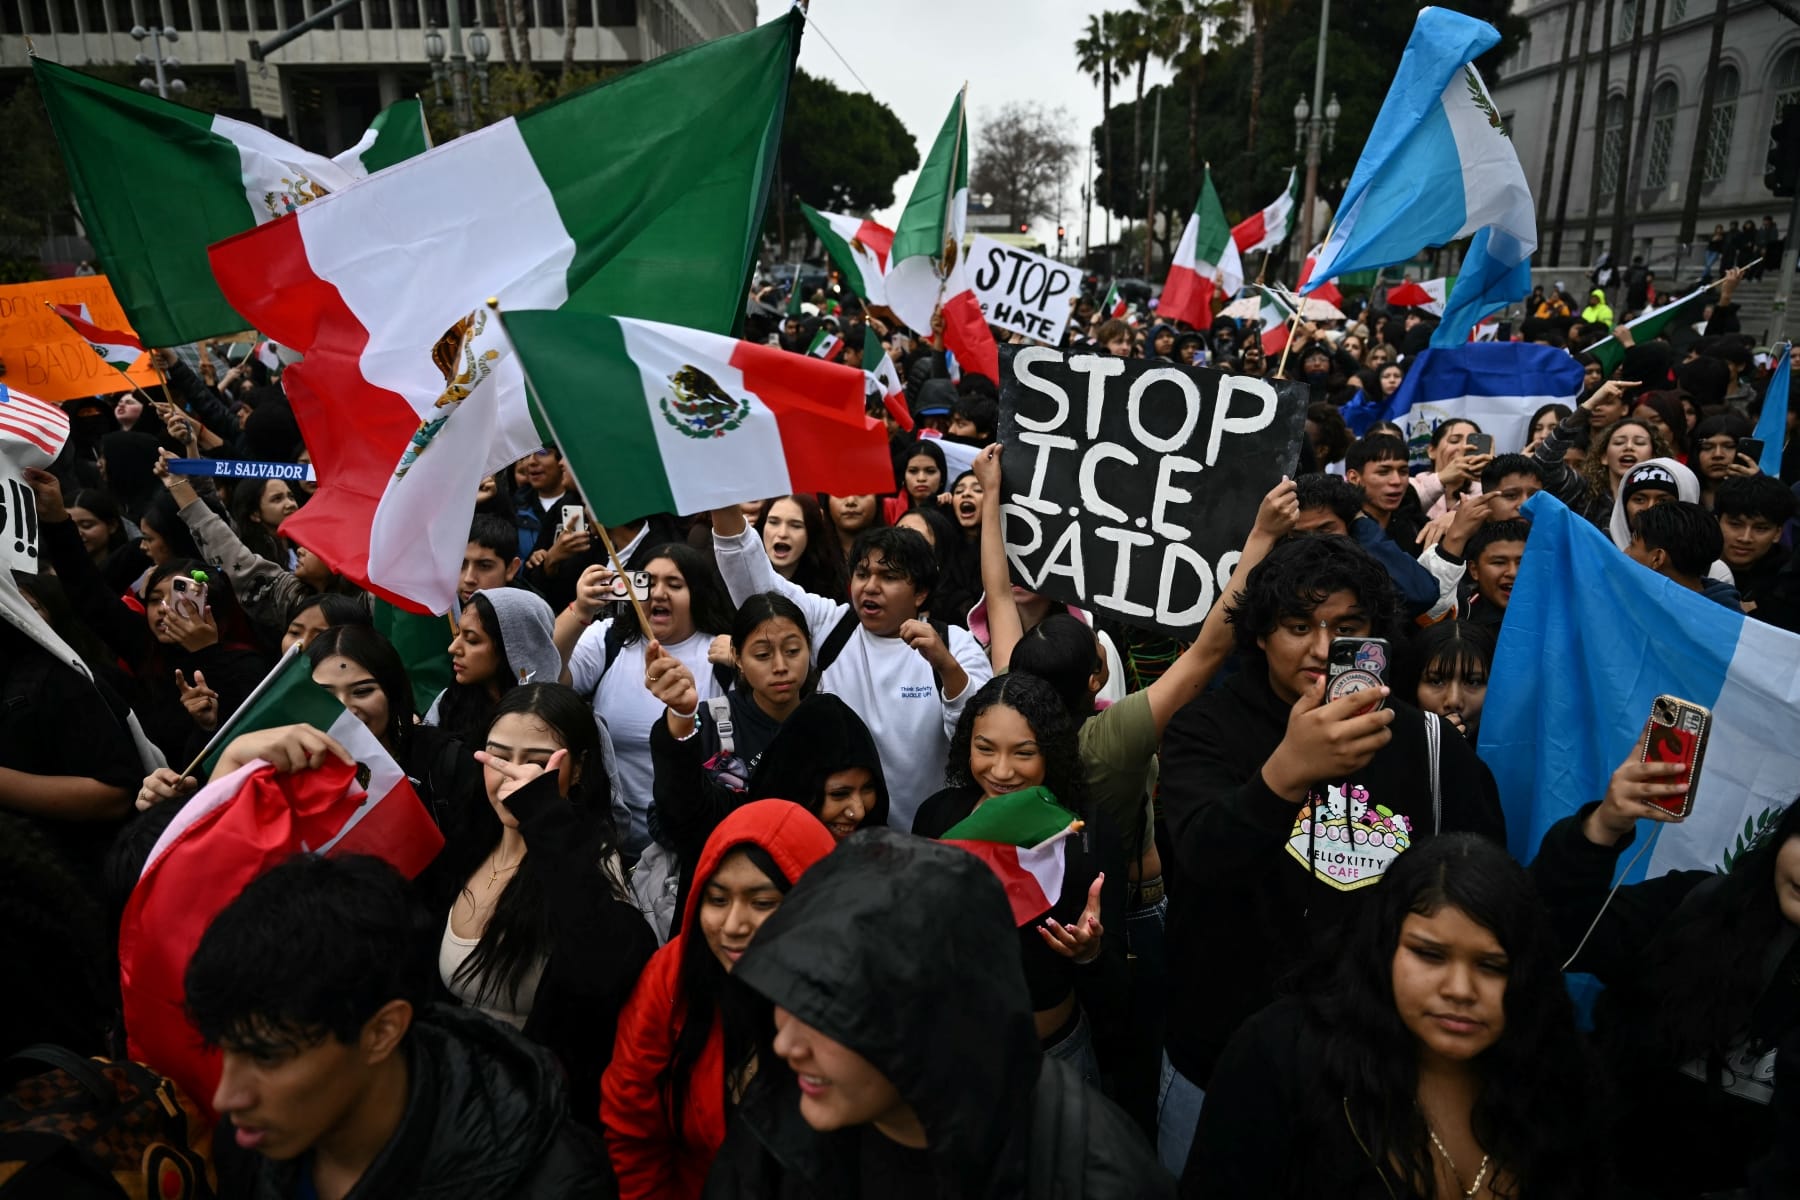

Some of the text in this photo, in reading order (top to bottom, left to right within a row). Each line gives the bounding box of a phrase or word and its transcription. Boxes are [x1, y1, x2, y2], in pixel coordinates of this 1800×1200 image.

[975, 247, 1071, 313] STOP
[993, 302, 1056, 343] HATE.
[1012, 345, 1279, 467] STOP
[214, 461, 303, 479] EL SALVADOR
[1302, 820, 1396, 847] WELCOME
[1327, 865, 1359, 878] CAFE
[1347, 855, 1384, 869] KITTY
